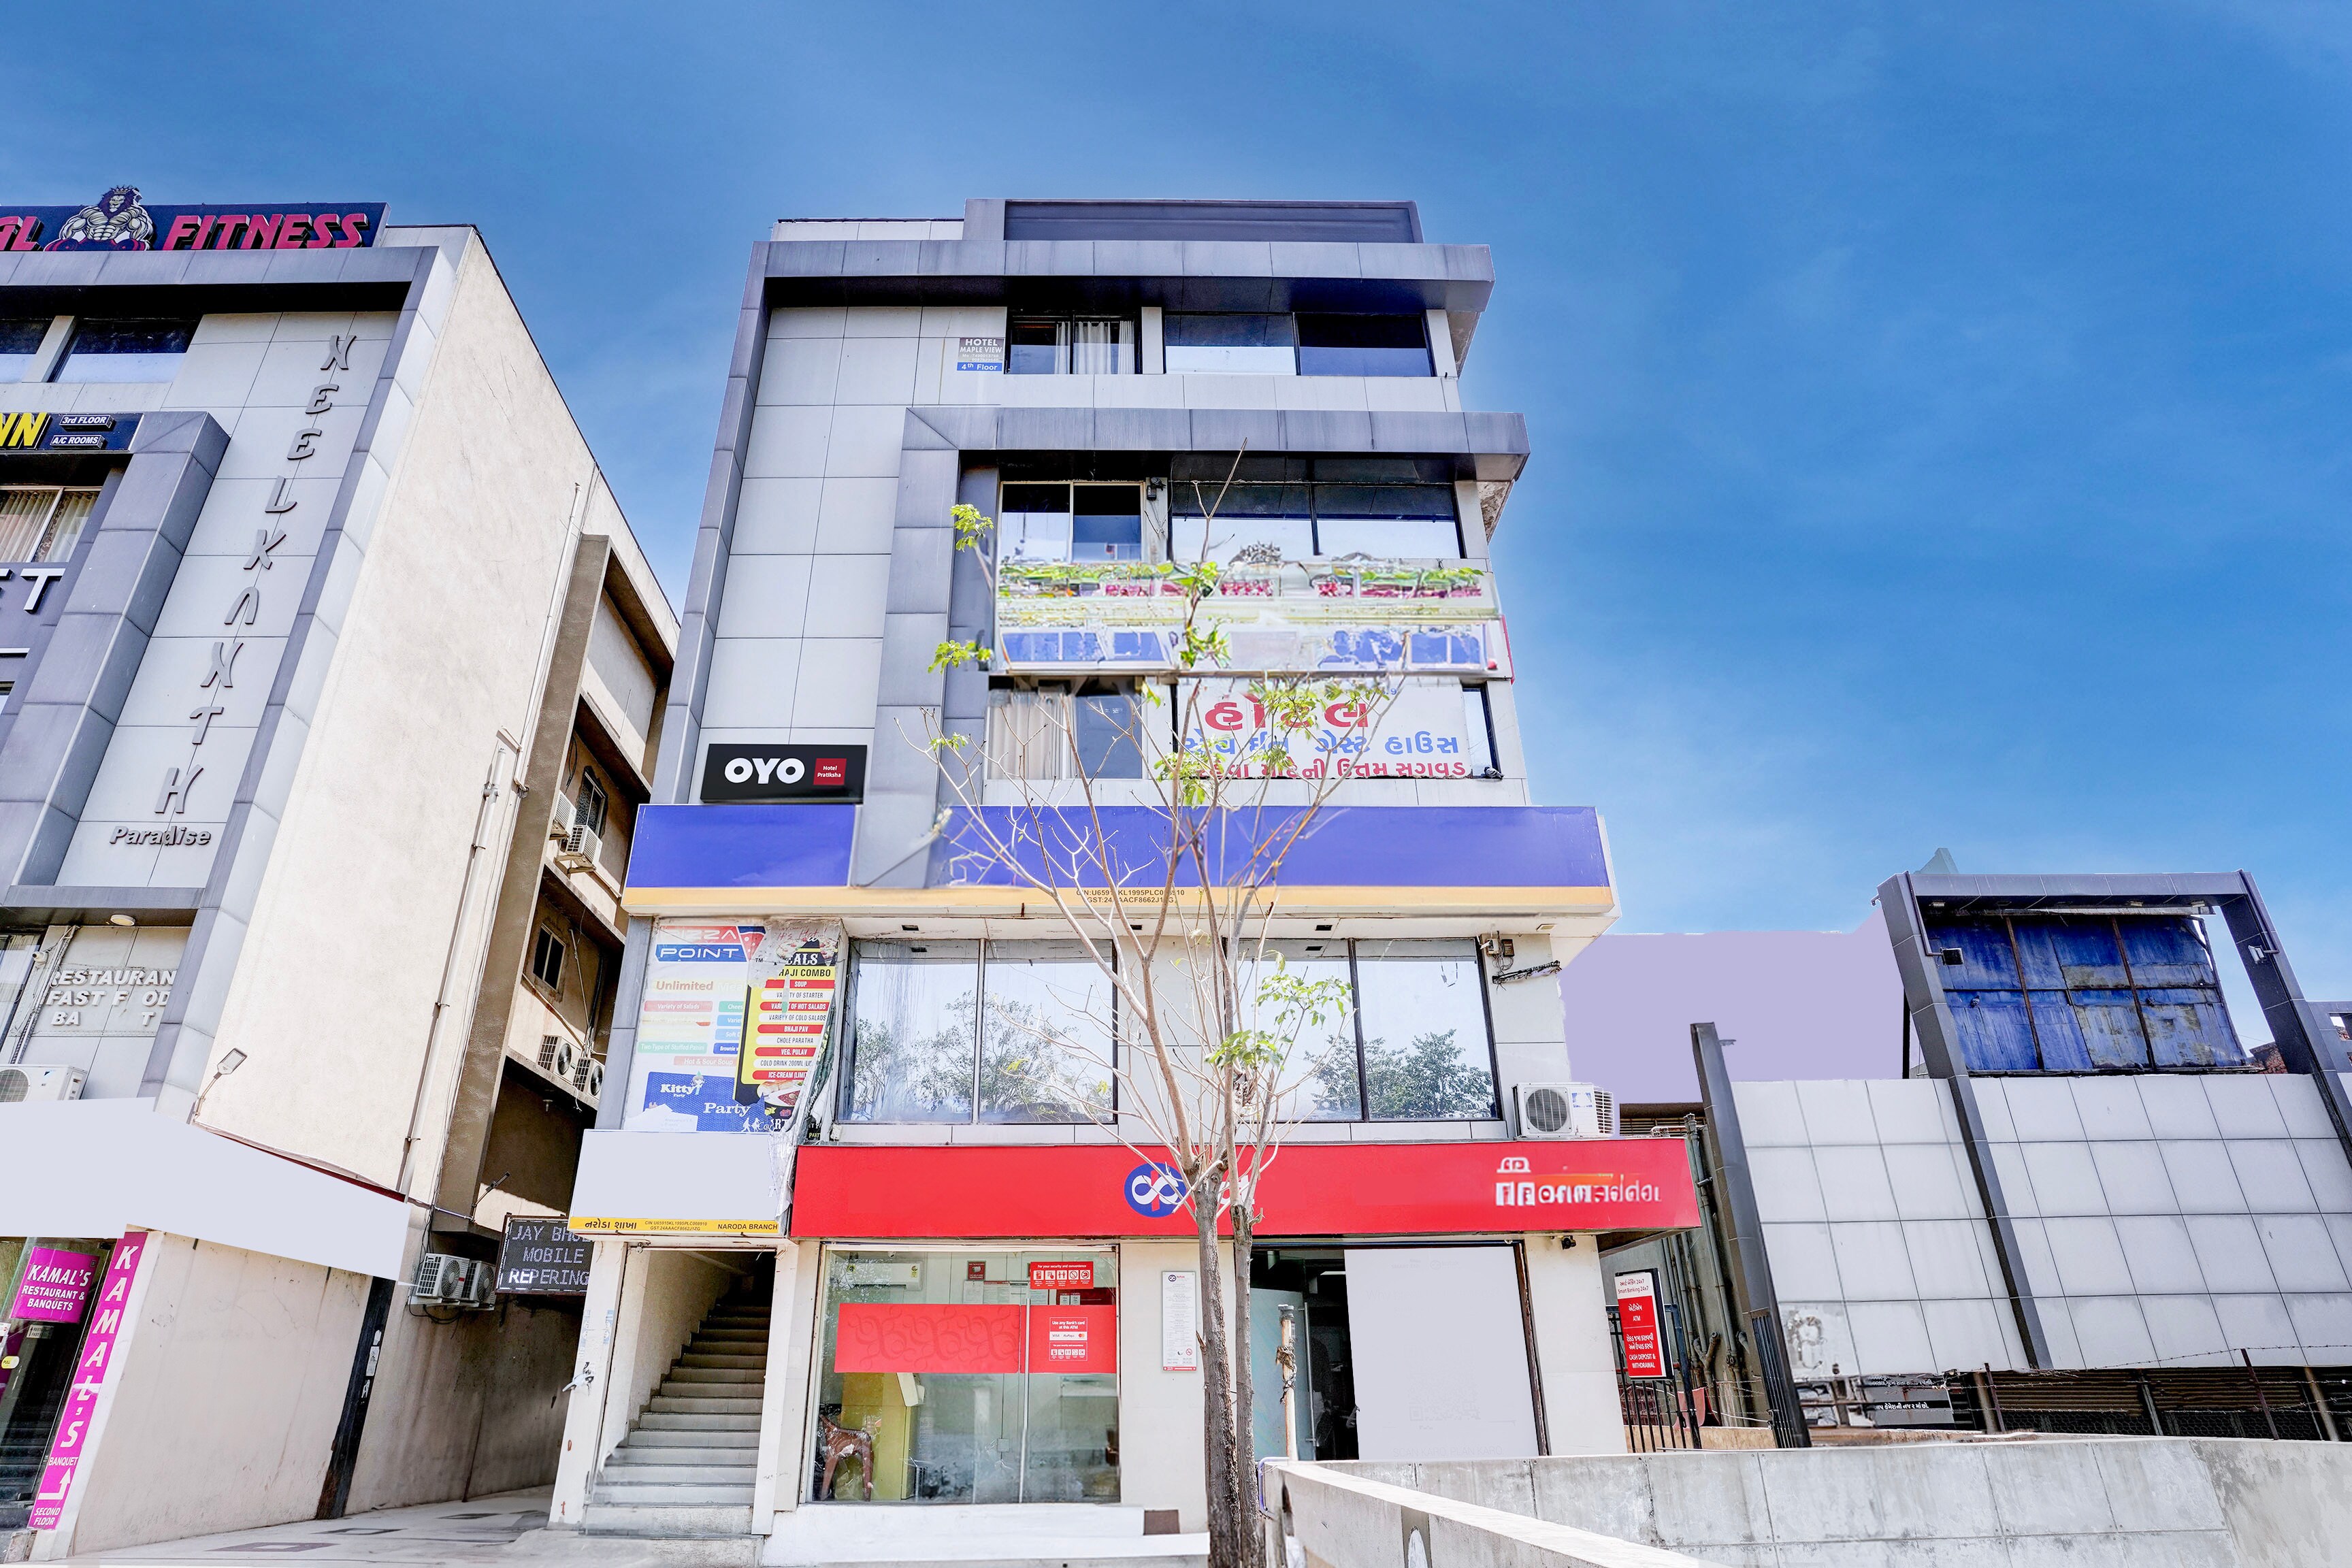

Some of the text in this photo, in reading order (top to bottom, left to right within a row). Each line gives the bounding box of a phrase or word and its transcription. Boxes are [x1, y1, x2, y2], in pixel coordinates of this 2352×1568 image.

[163, 214, 368, 250] FITNESS
[52, 436, 99, 444] A/C ROOMS
[1384, 731, 1459, 755] હાઉસ
[724, 757, 806, 784] OYO
[1396, 762, 1466, 777] સગવડ
[109, 826, 212, 848] Paradise
[660, 948, 739, 958] POINT
[800, 968, 831, 977] COMBO
[656, 981, 714, 991] Unlimited
[46, 990, 107, 1007] FAST
[660, 1083, 695, 1095] Kitty
[703, 1102, 751, 1117] Party
[585, 1218, 637, 1229] નરોડા શાખા
[512, 1225, 545, 1240] JAY
[523, 1247, 585, 1264] MOBILE
[27, 1264, 92, 1287] KAMAL'S
[508, 1268, 589, 1286] REPERING
[21, 1285, 85, 1301] RESTAURANT &
[27, 1298, 74, 1311] BANQUETS
[60, 1245, 139, 1448] KAMAL'S
[48, 1456, 79, 1466] BANQUET
[34, 1507, 61, 1516] SECOND
[33, 1517, 56, 1526] FLOOR
